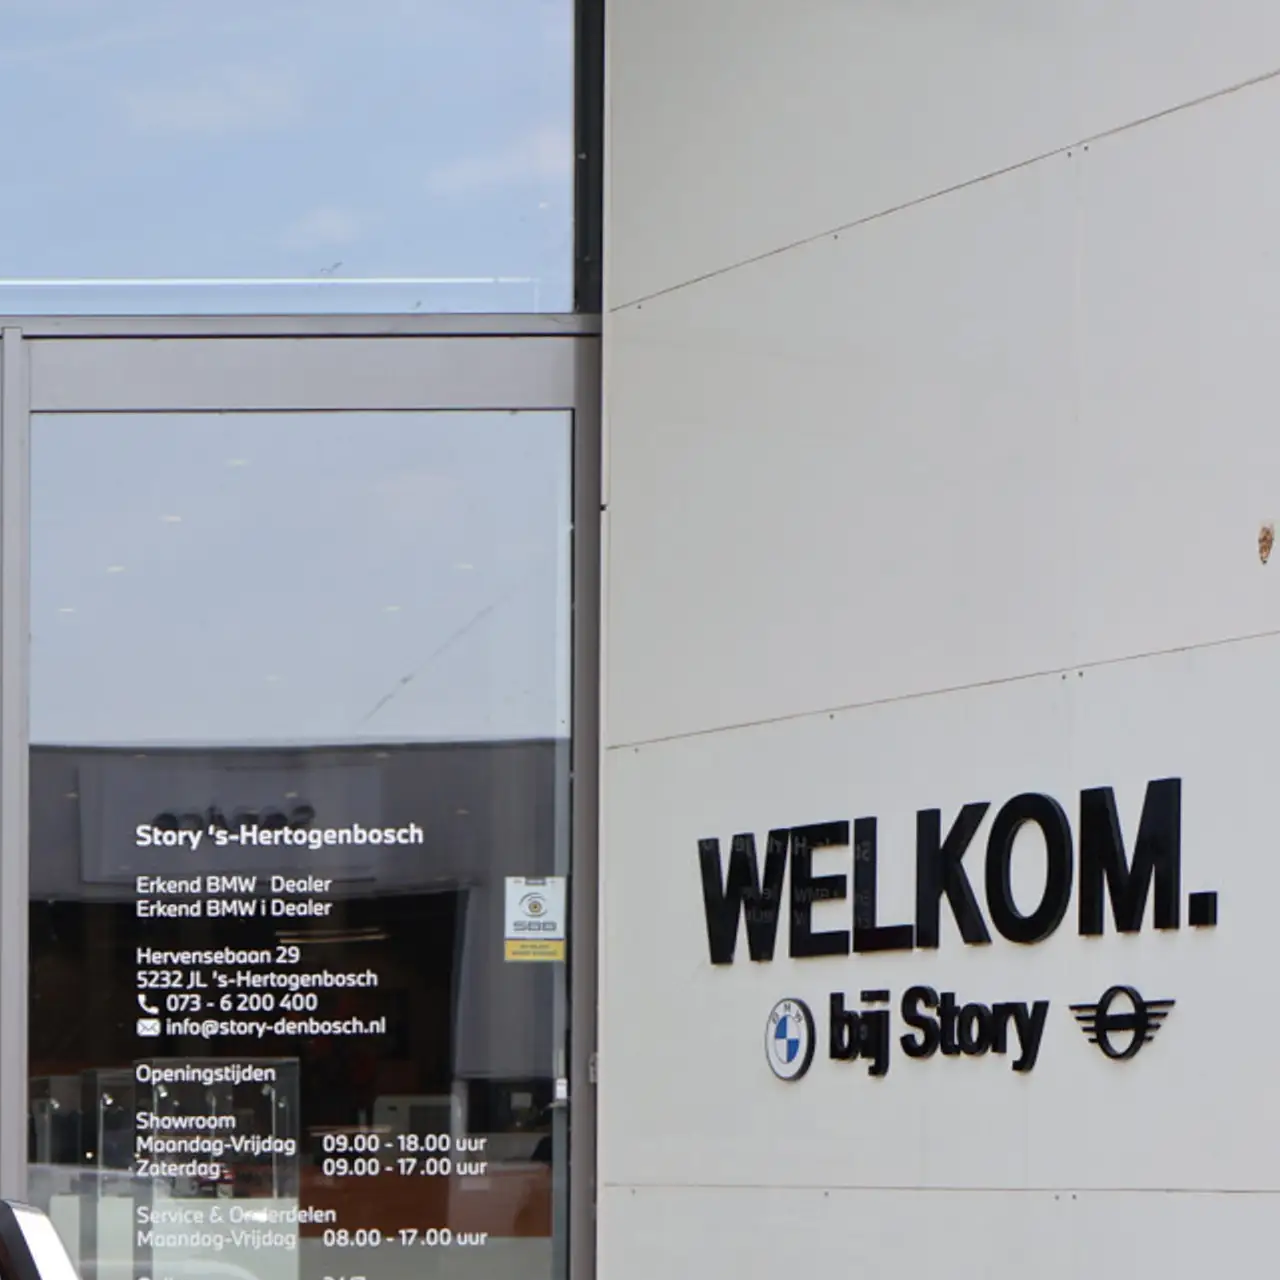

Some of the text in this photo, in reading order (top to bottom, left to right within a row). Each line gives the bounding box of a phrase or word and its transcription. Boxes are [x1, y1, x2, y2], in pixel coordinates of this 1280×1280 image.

[135, 825, 203, 850] Story
[698, 777, 1218, 965] WELKOM.
[136, 875, 332, 895] Erkend BMW Dealer
[136, 899, 333, 919] Erkend BMW i Dealer
[136, 945, 301, 966] Hervensebaan 29
[136, 969, 184, 990] 5232
[186, 969, 209, 990] JL
[166, 994, 202, 1013] 073
[219, 994, 233, 1012] 6
[237, 993, 275, 1012] 200
[279, 993, 318, 1012] 400
[165, 1015, 387, 1039] info@story-denbosch.nl
[829, 986, 1049, 1077] bij Story
[136, 1064, 277, 1087] Openingstijden
[136, 1111, 236, 1131] Showroom
[136, 1135, 297, 1157] Maandag-Vrijdag
[322, 1134, 381, 1153] 09.00
[397, 1133, 451, 1152] 18.00
[455, 1137, 488, 1151] uur
[136, 1159, 222, 1180] Zaterdag
[322, 1158, 381, 1177] 09.00
[455, 1161, 488, 1176] uur
[136, 1205, 337, 1224] Service & Onderdelen
[136, 1229, 297, 1251] Maandag-Vrijdag
[322, 1229, 381, 1248] 08.00
[455, 1232, 488, 1246] uur
